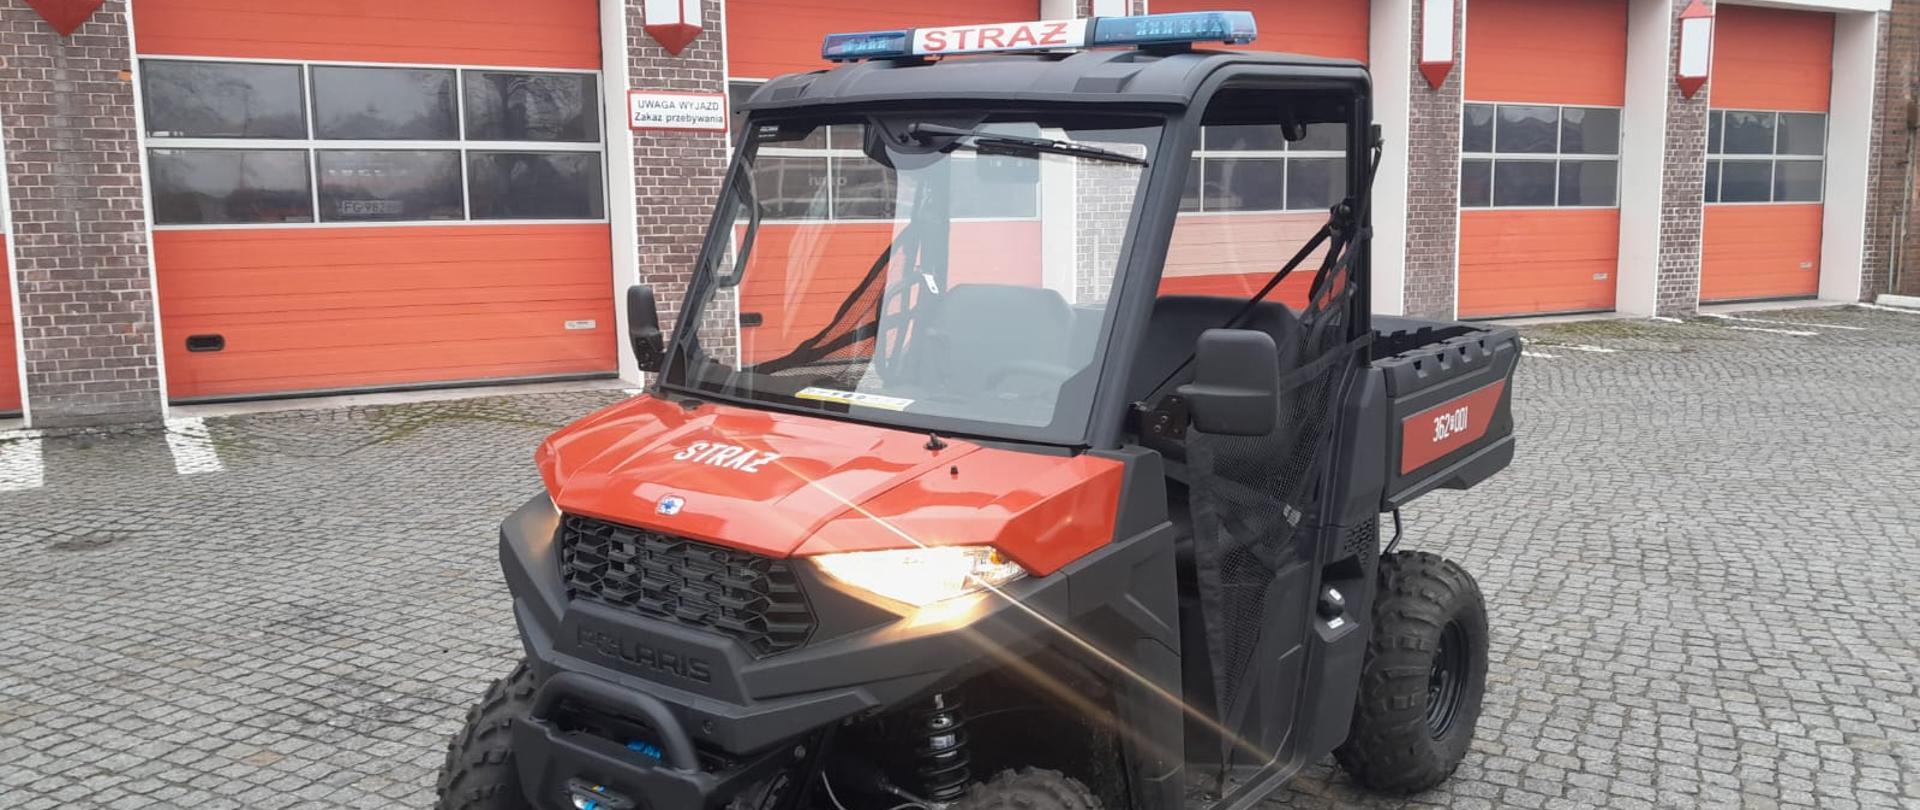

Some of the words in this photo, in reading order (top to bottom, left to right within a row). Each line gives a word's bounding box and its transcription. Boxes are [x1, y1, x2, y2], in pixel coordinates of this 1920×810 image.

[638, 99, 676, 109] UWAGA
[679, 101, 719, 111] WYJAZD
[634, 111, 663, 121] Zakaz
[665, 113, 724, 124] przebywania
[576, 624, 713, 685] POLARIS
